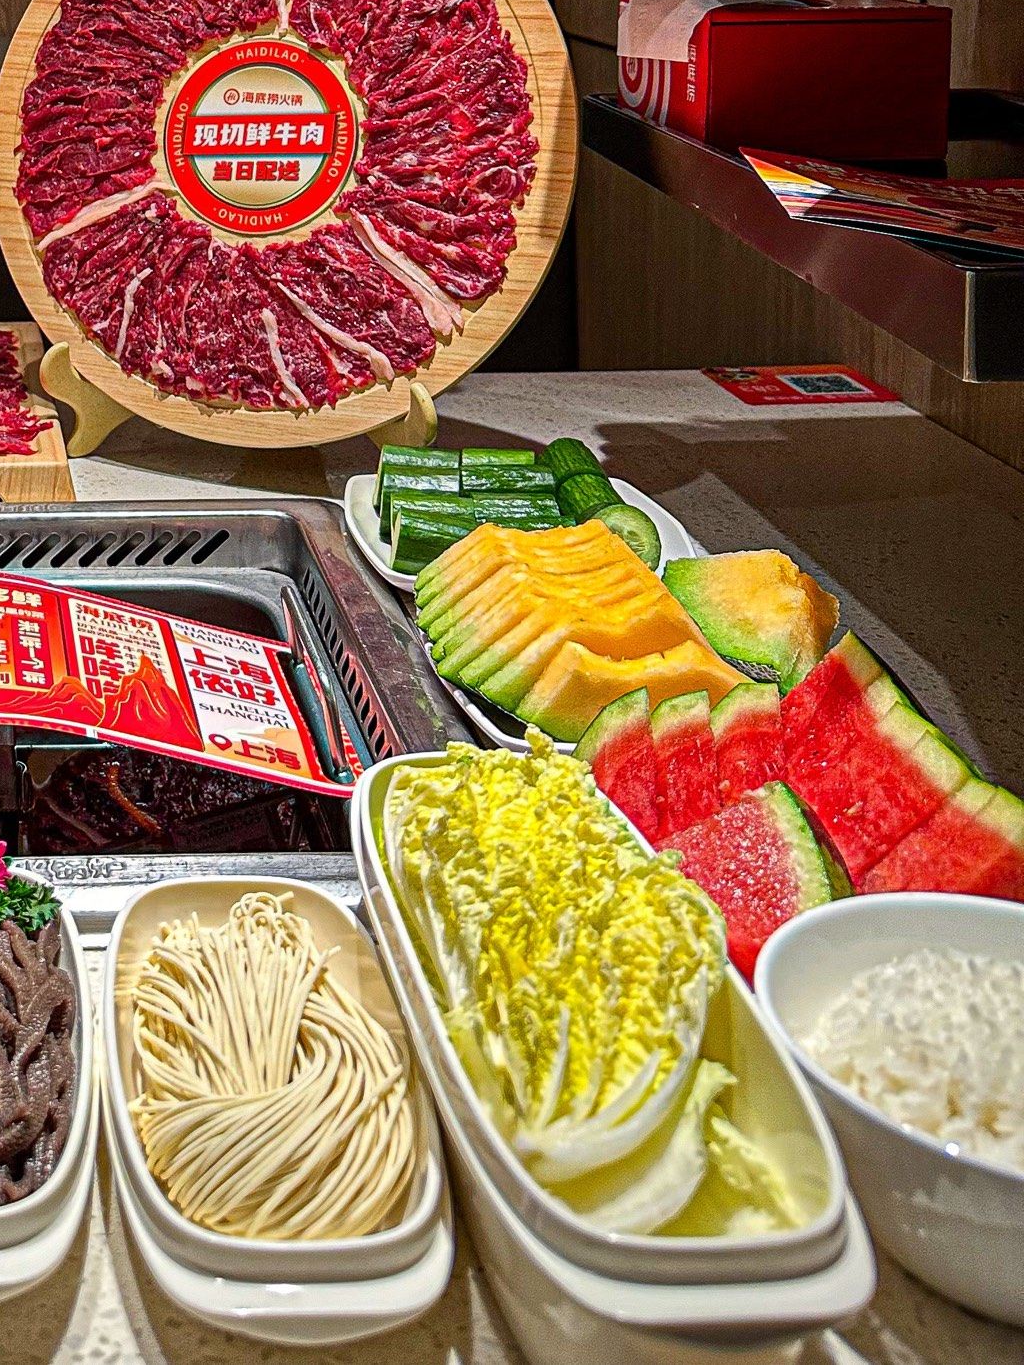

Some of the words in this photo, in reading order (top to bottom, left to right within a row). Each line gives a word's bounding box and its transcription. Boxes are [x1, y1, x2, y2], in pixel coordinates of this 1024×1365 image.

[235, 46, 300, 62] HAIDILAO
[241, 91, 303, 106] 海底捞火锅
[172, 101, 189, 167] HAIDILAO
[193, 122, 324, 147] 现切鲜牛肉
[328, 110, 347, 179] HAIDILAO
[212, 160, 300, 182] 当日配送
[218, 208, 283, 226] HAIDILAO
[76, 603, 154, 632] 海底捞
[77, 614, 157, 638] HAIDILAO
[175, 623, 258, 648] SHANGHAI
[183, 630, 260, 655] HAIDILAO
[184, 647, 274, 684] 上海
[189, 668, 281, 706] 侬好
[198, 702, 290, 729] SHANGHAI
[231, 702, 288, 721] HELLO
[234, 739, 302, 770] 上海
